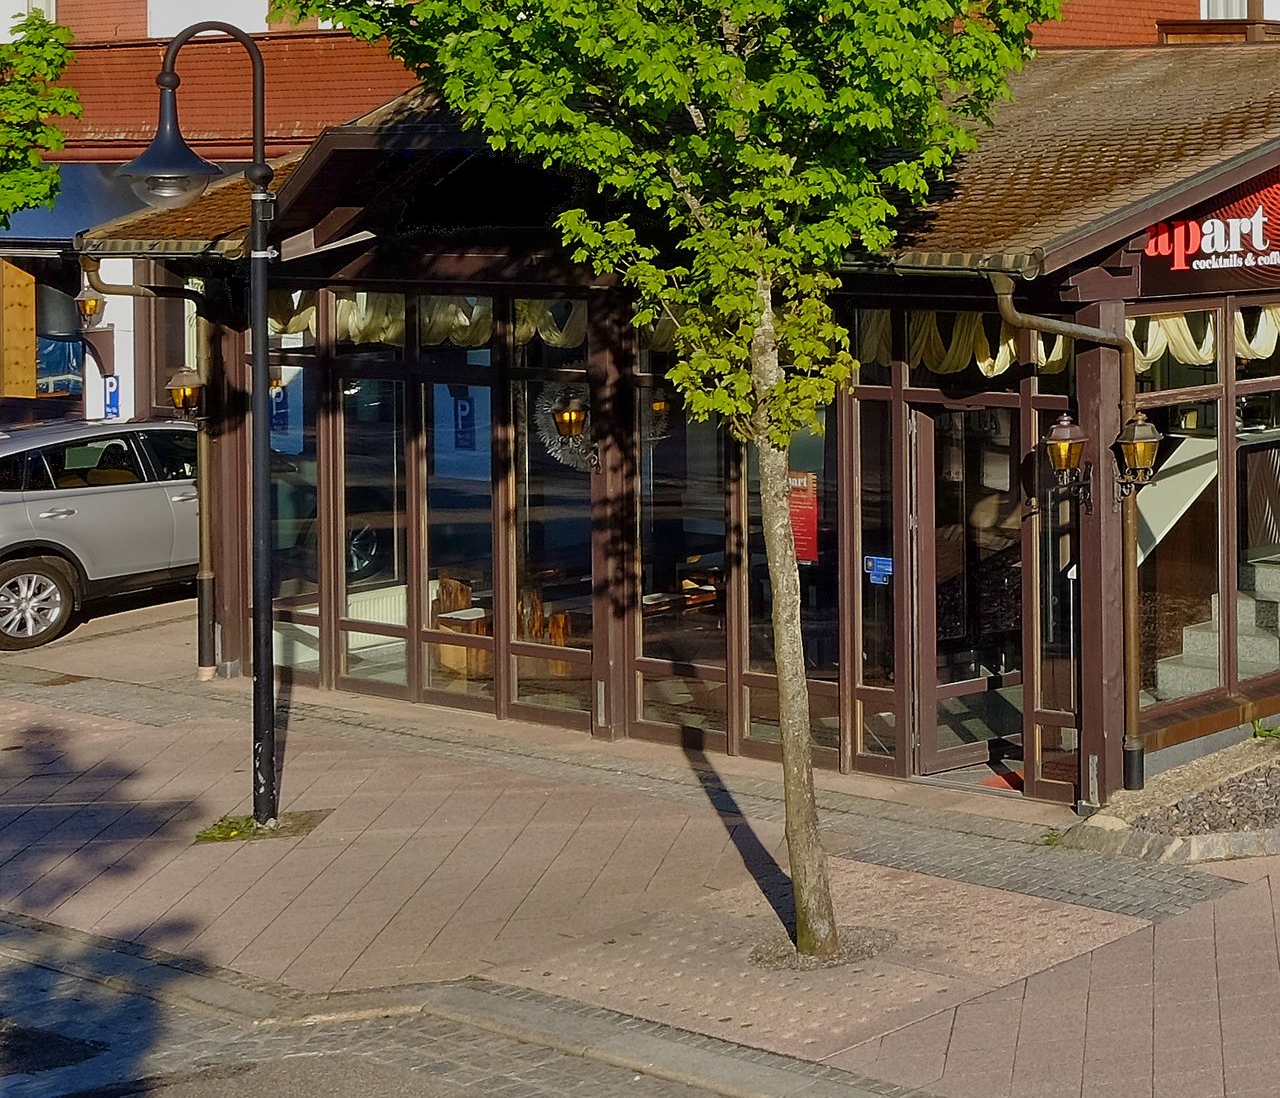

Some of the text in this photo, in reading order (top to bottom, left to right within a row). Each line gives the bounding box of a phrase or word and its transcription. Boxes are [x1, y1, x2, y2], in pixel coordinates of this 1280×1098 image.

[1144, 204, 1270, 271] apart
[1192, 254, 1244, 271] cocktails
[1244, 252, 1257, 267] &
[106, 376, 118, 405] P
[457, 399, 470, 430] P
[788, 475, 808, 489] art
